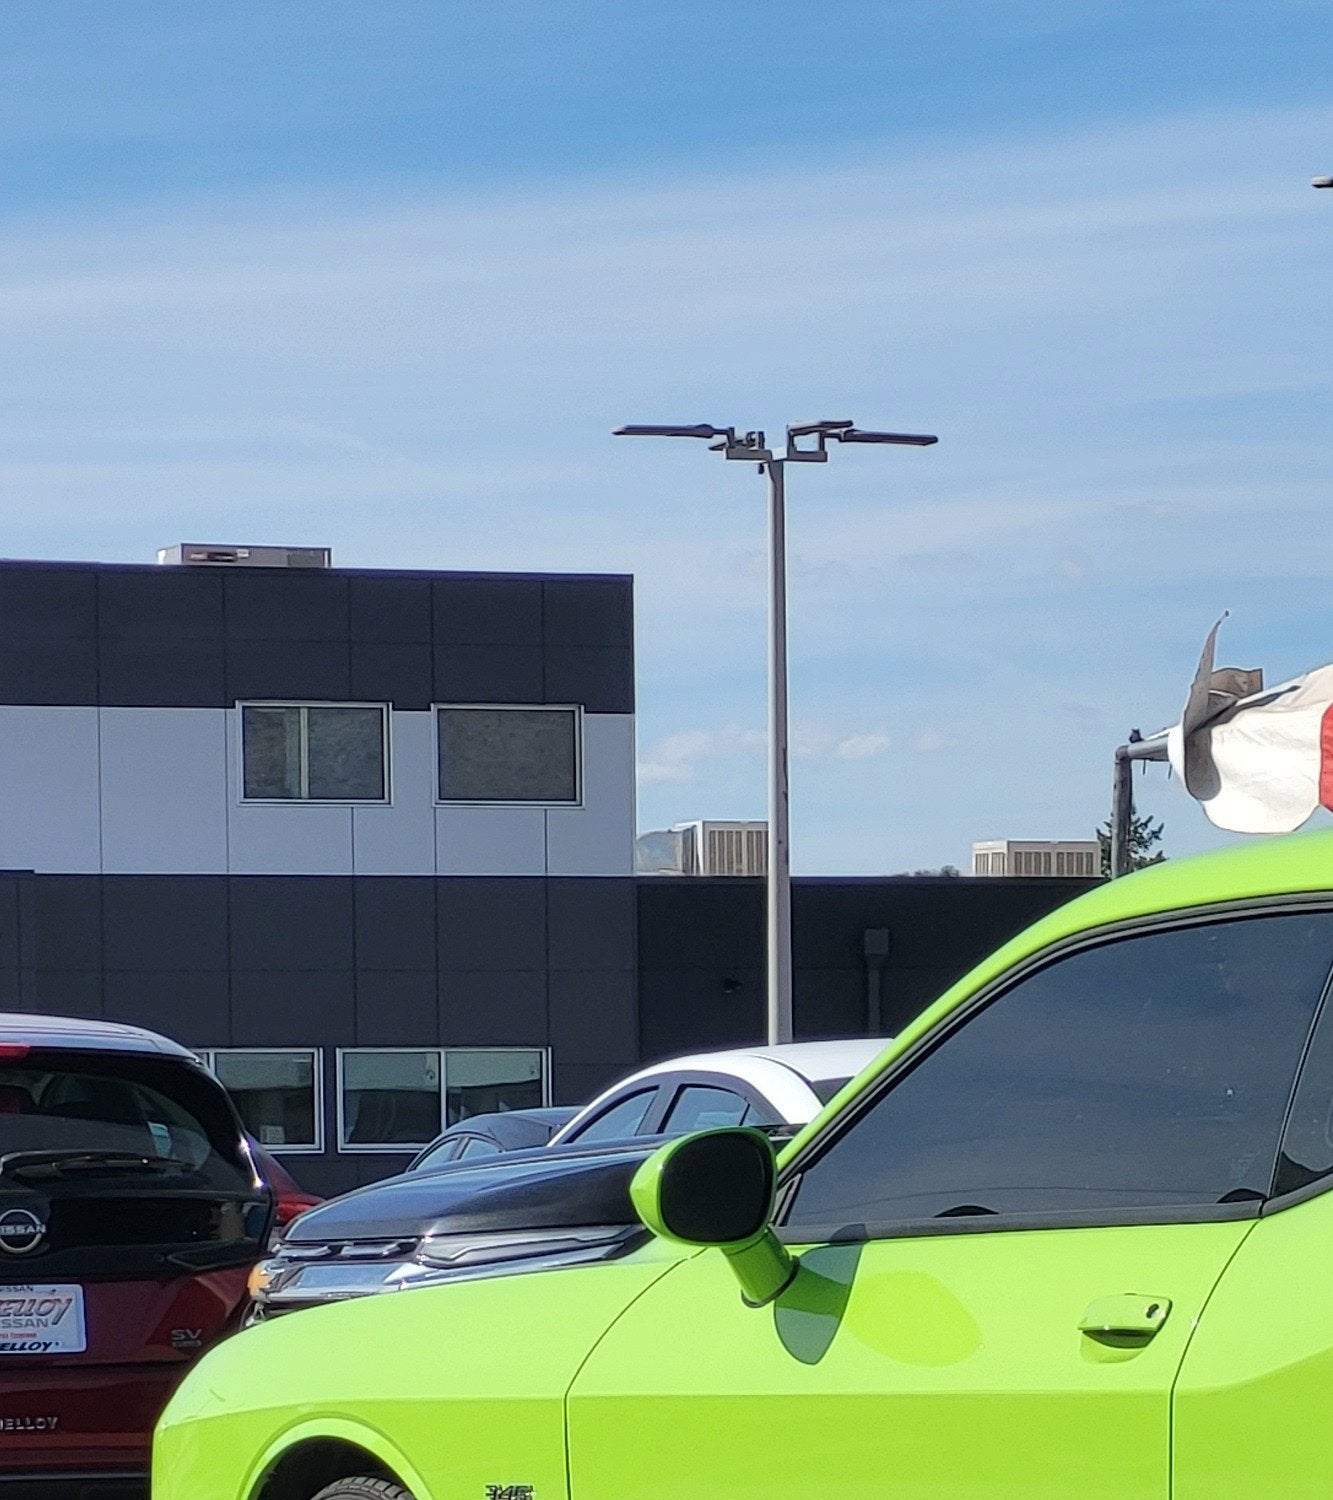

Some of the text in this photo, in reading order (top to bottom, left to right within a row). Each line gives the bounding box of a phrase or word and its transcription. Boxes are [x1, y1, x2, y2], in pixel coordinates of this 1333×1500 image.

[0, 1225, 46, 1235] ISSAN
[0, 1298, 73, 1325] ELLOY
[171, 1329, 202, 1340] SV
[0, 1341, 53, 1351] ELLOY
[0, 1416, 58, 1430] ELLOY
